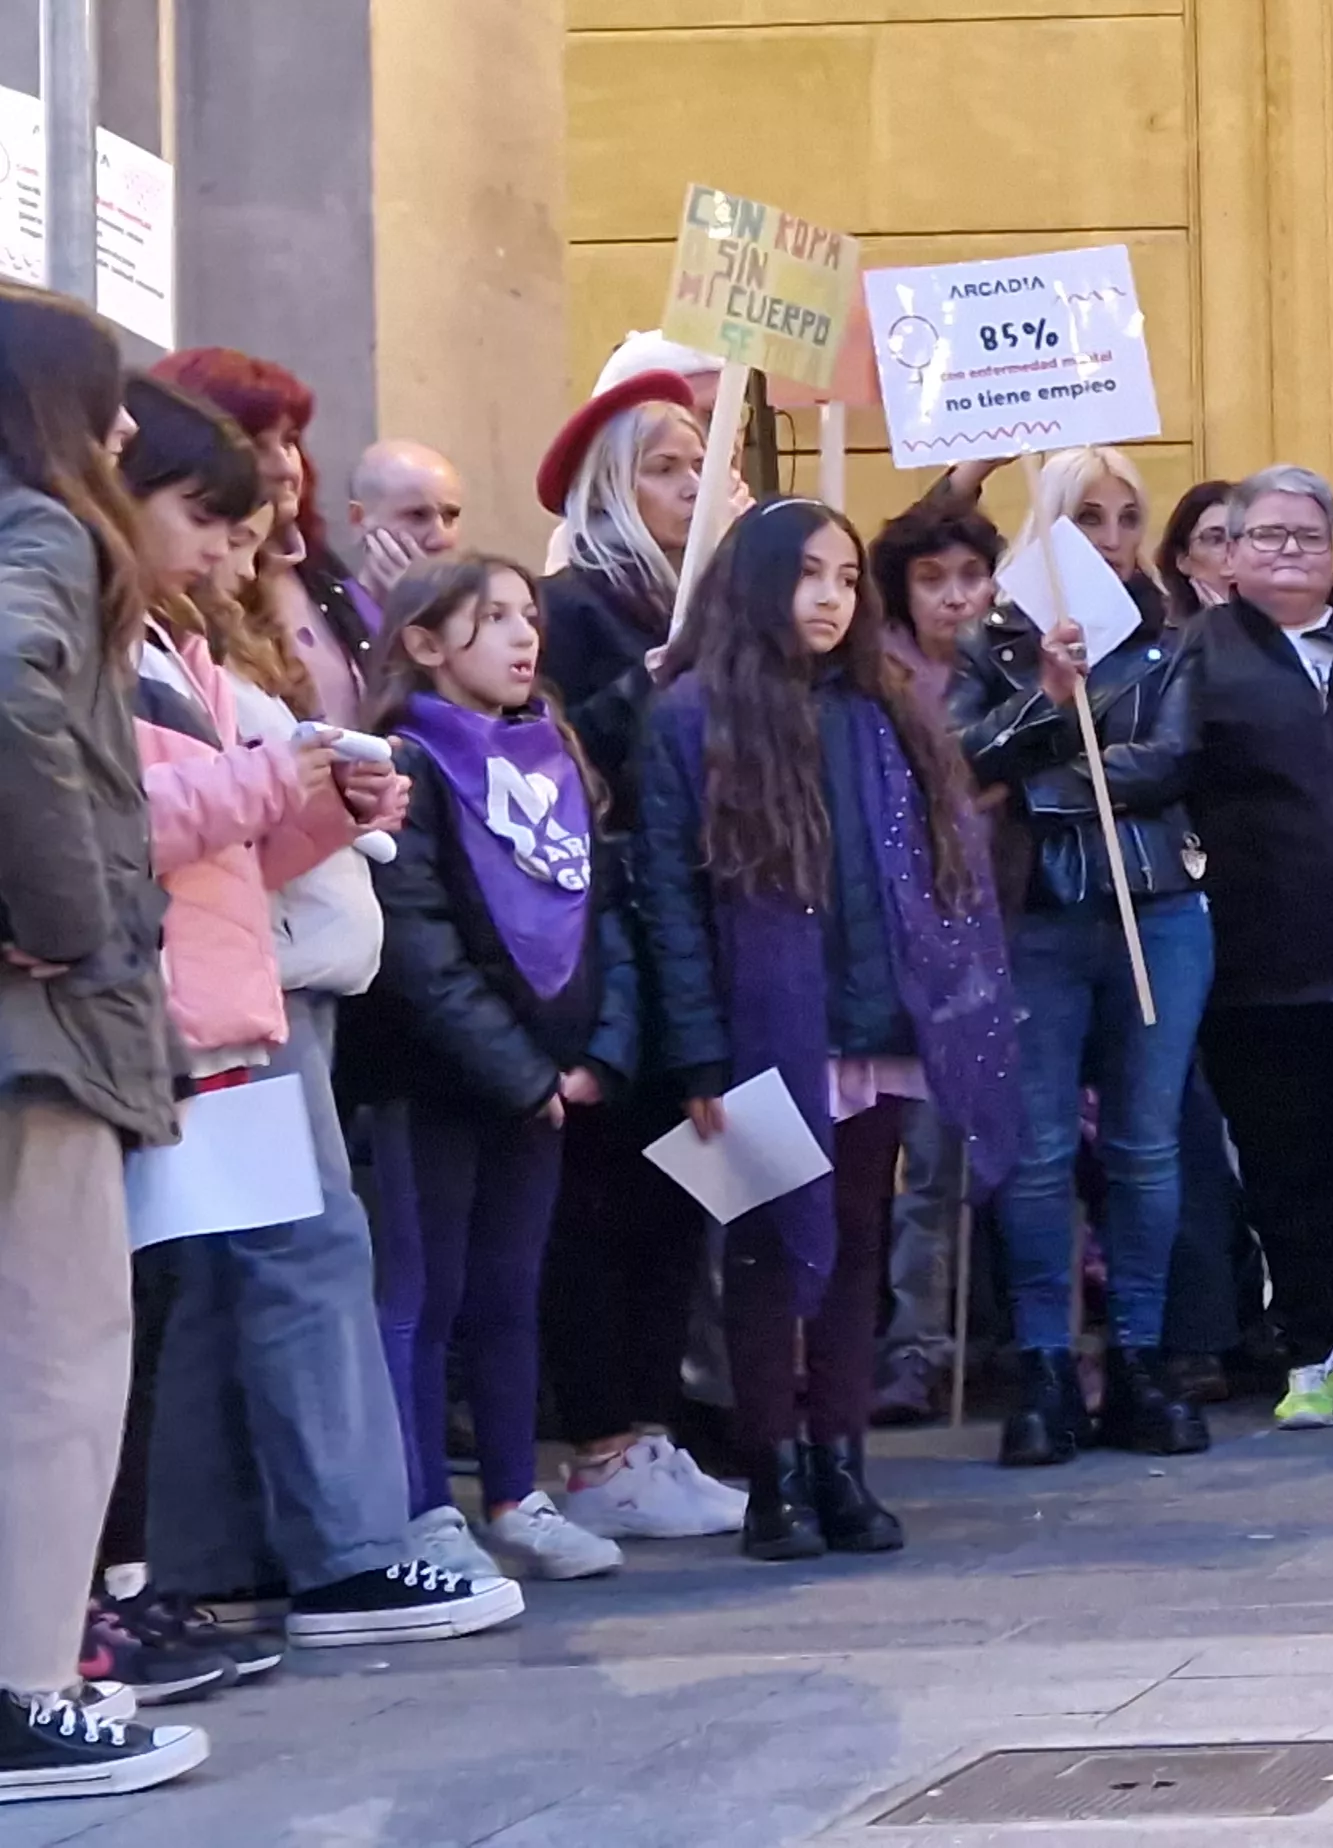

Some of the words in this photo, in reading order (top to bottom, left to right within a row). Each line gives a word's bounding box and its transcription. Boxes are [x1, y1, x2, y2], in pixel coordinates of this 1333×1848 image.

[774, 211, 842, 270] ROPA
[717, 238, 768, 290] SIN
[950, 276, 1045, 298] ARCADIA
[726, 284, 832, 346] CUERPO
[980, 317, 1059, 351] 85%
[1062, 350, 1113, 366] mtal
[946, 397, 972, 412] no
[978, 389, 1031, 408] tiene
